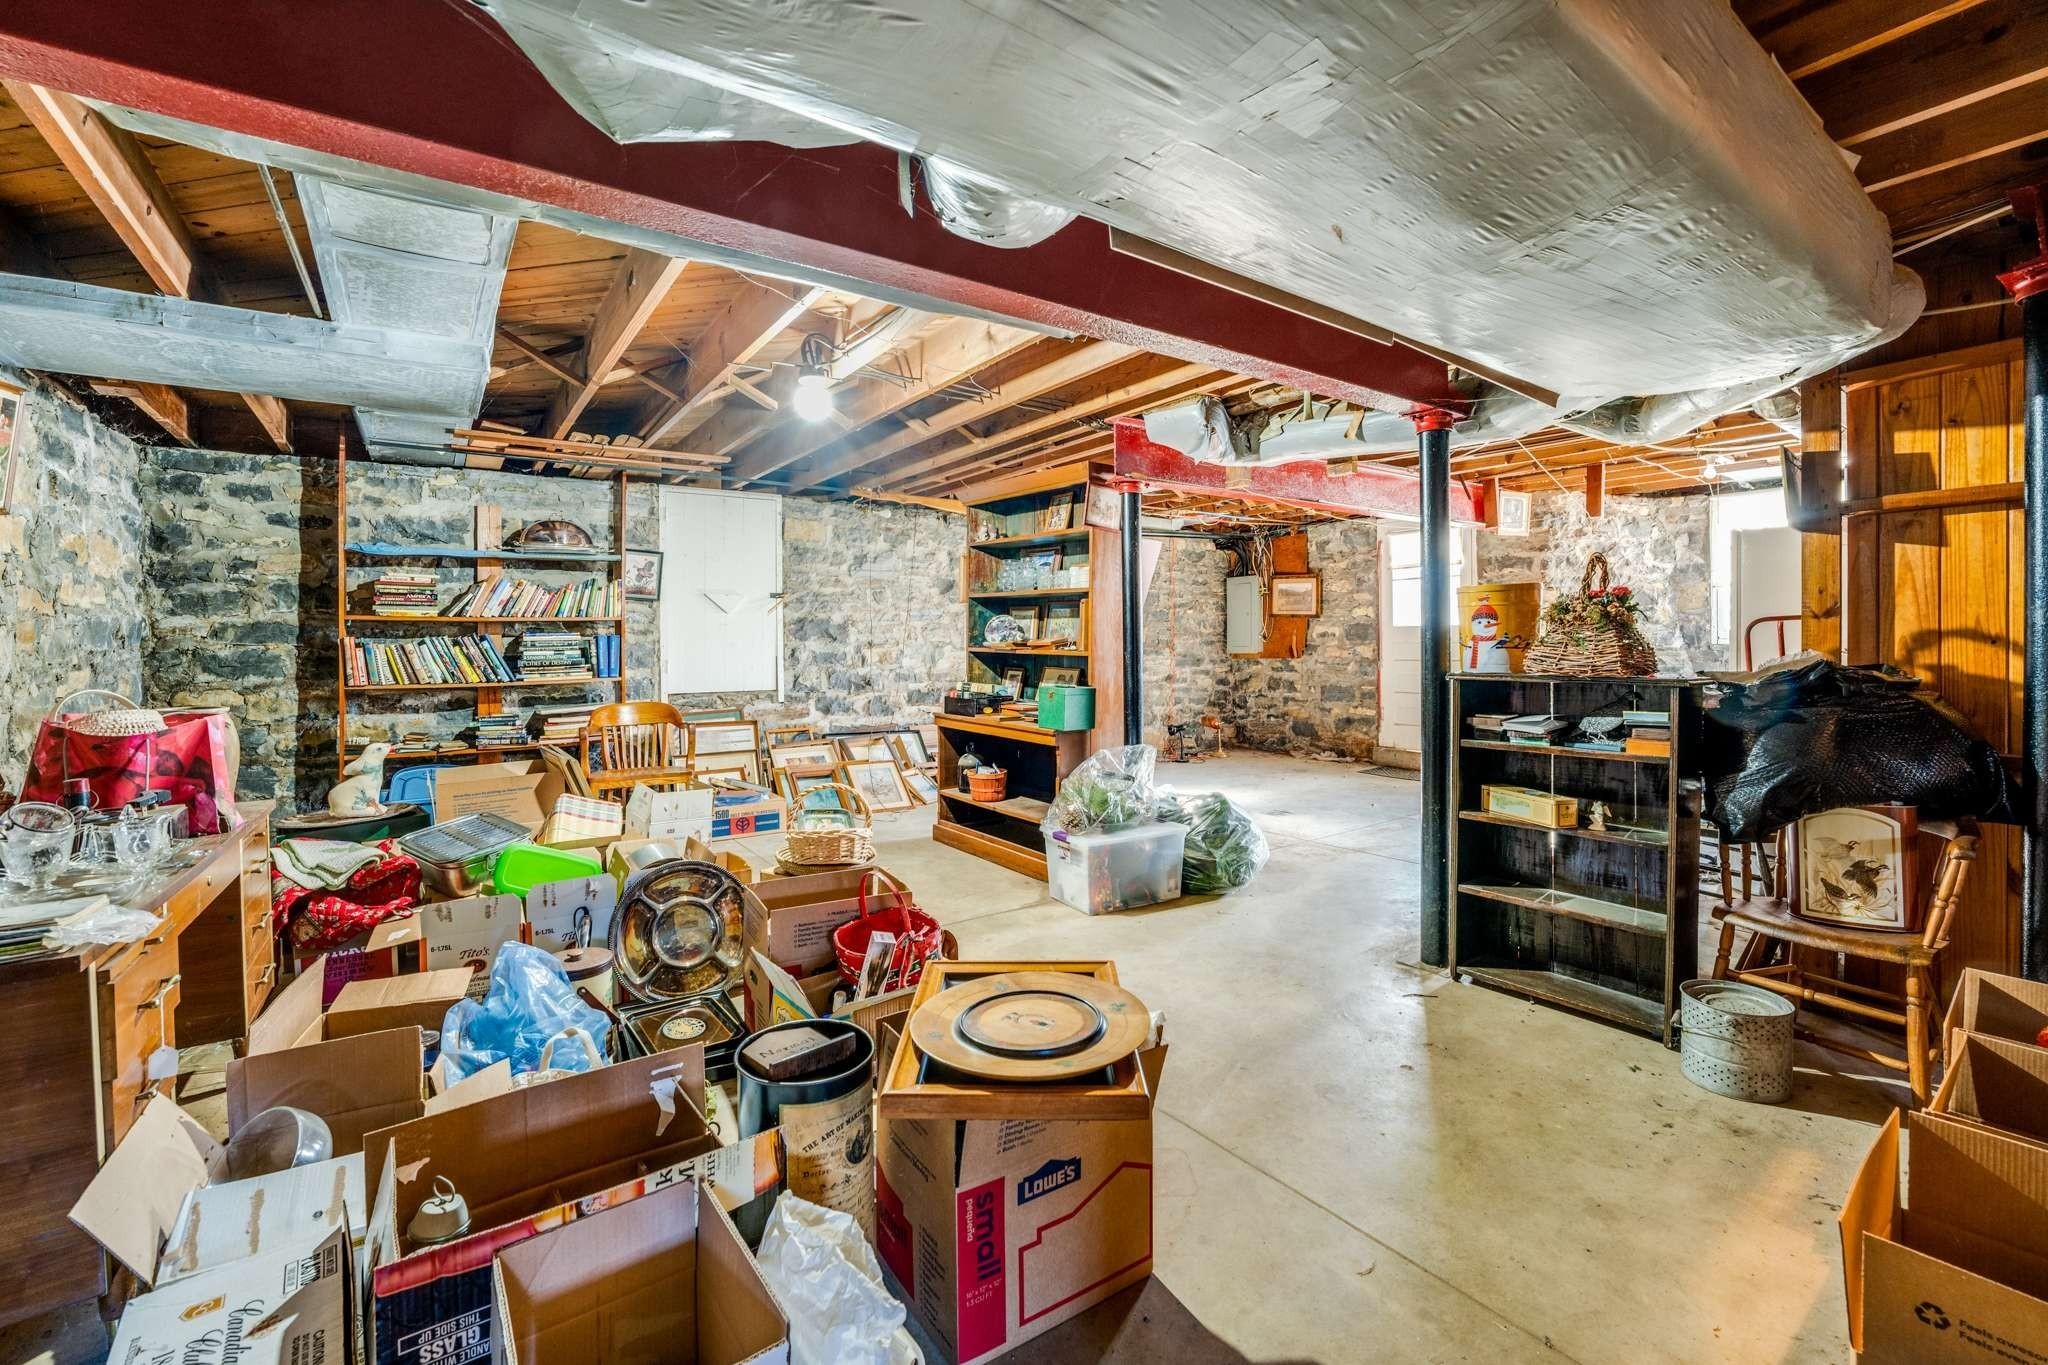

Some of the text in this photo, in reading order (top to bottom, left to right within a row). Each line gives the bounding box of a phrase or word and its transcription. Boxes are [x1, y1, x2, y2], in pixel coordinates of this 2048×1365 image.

[459, 946, 491, 960] Tito's
[802, 1140, 819, 1153] THE
[821, 1129, 836, 1143] ART
[1024, 1165, 1076, 1199] LOWE'S
[966, 1198, 974, 1242] pequeña
[976, 1191, 1002, 1281] small
[222, 1299, 265, 1365] Canadia
[418, 1311, 481, 1345] THIS SIDE UP
[419, 1325, 481, 1363] GLASS
[1959, 1319, 1993, 1341] Feels
[1959, 1330, 1993, 1352] Feels
[459, 1341, 490, 1362] ANDLE
